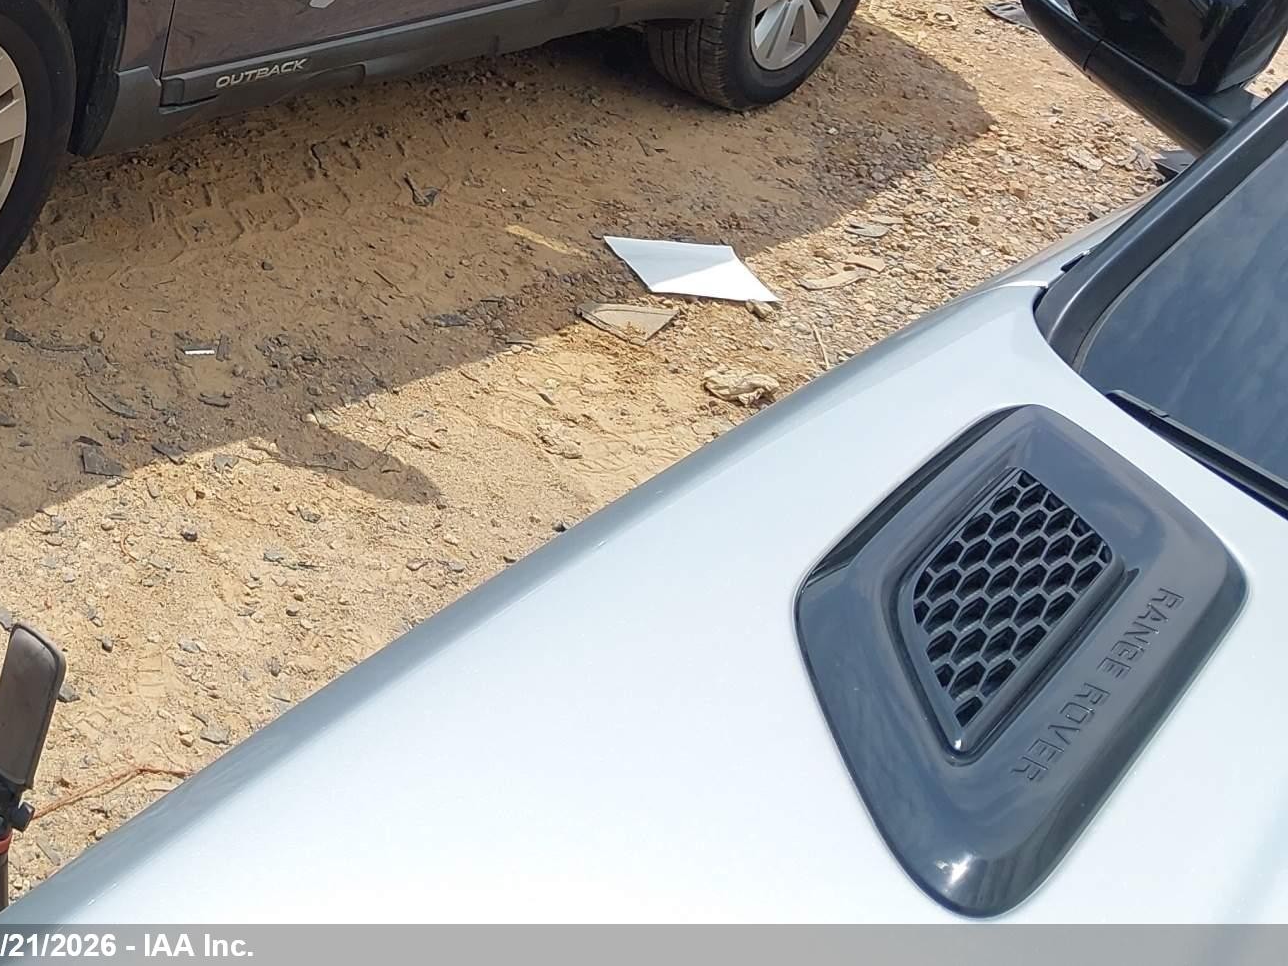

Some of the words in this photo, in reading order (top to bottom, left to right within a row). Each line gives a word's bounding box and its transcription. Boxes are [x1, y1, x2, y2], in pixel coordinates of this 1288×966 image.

[215, 58, 308, 88] OUTBACK
[1096, 587, 1184, 679] RANGE
[1011, 682, 1112, 781] ROVER
